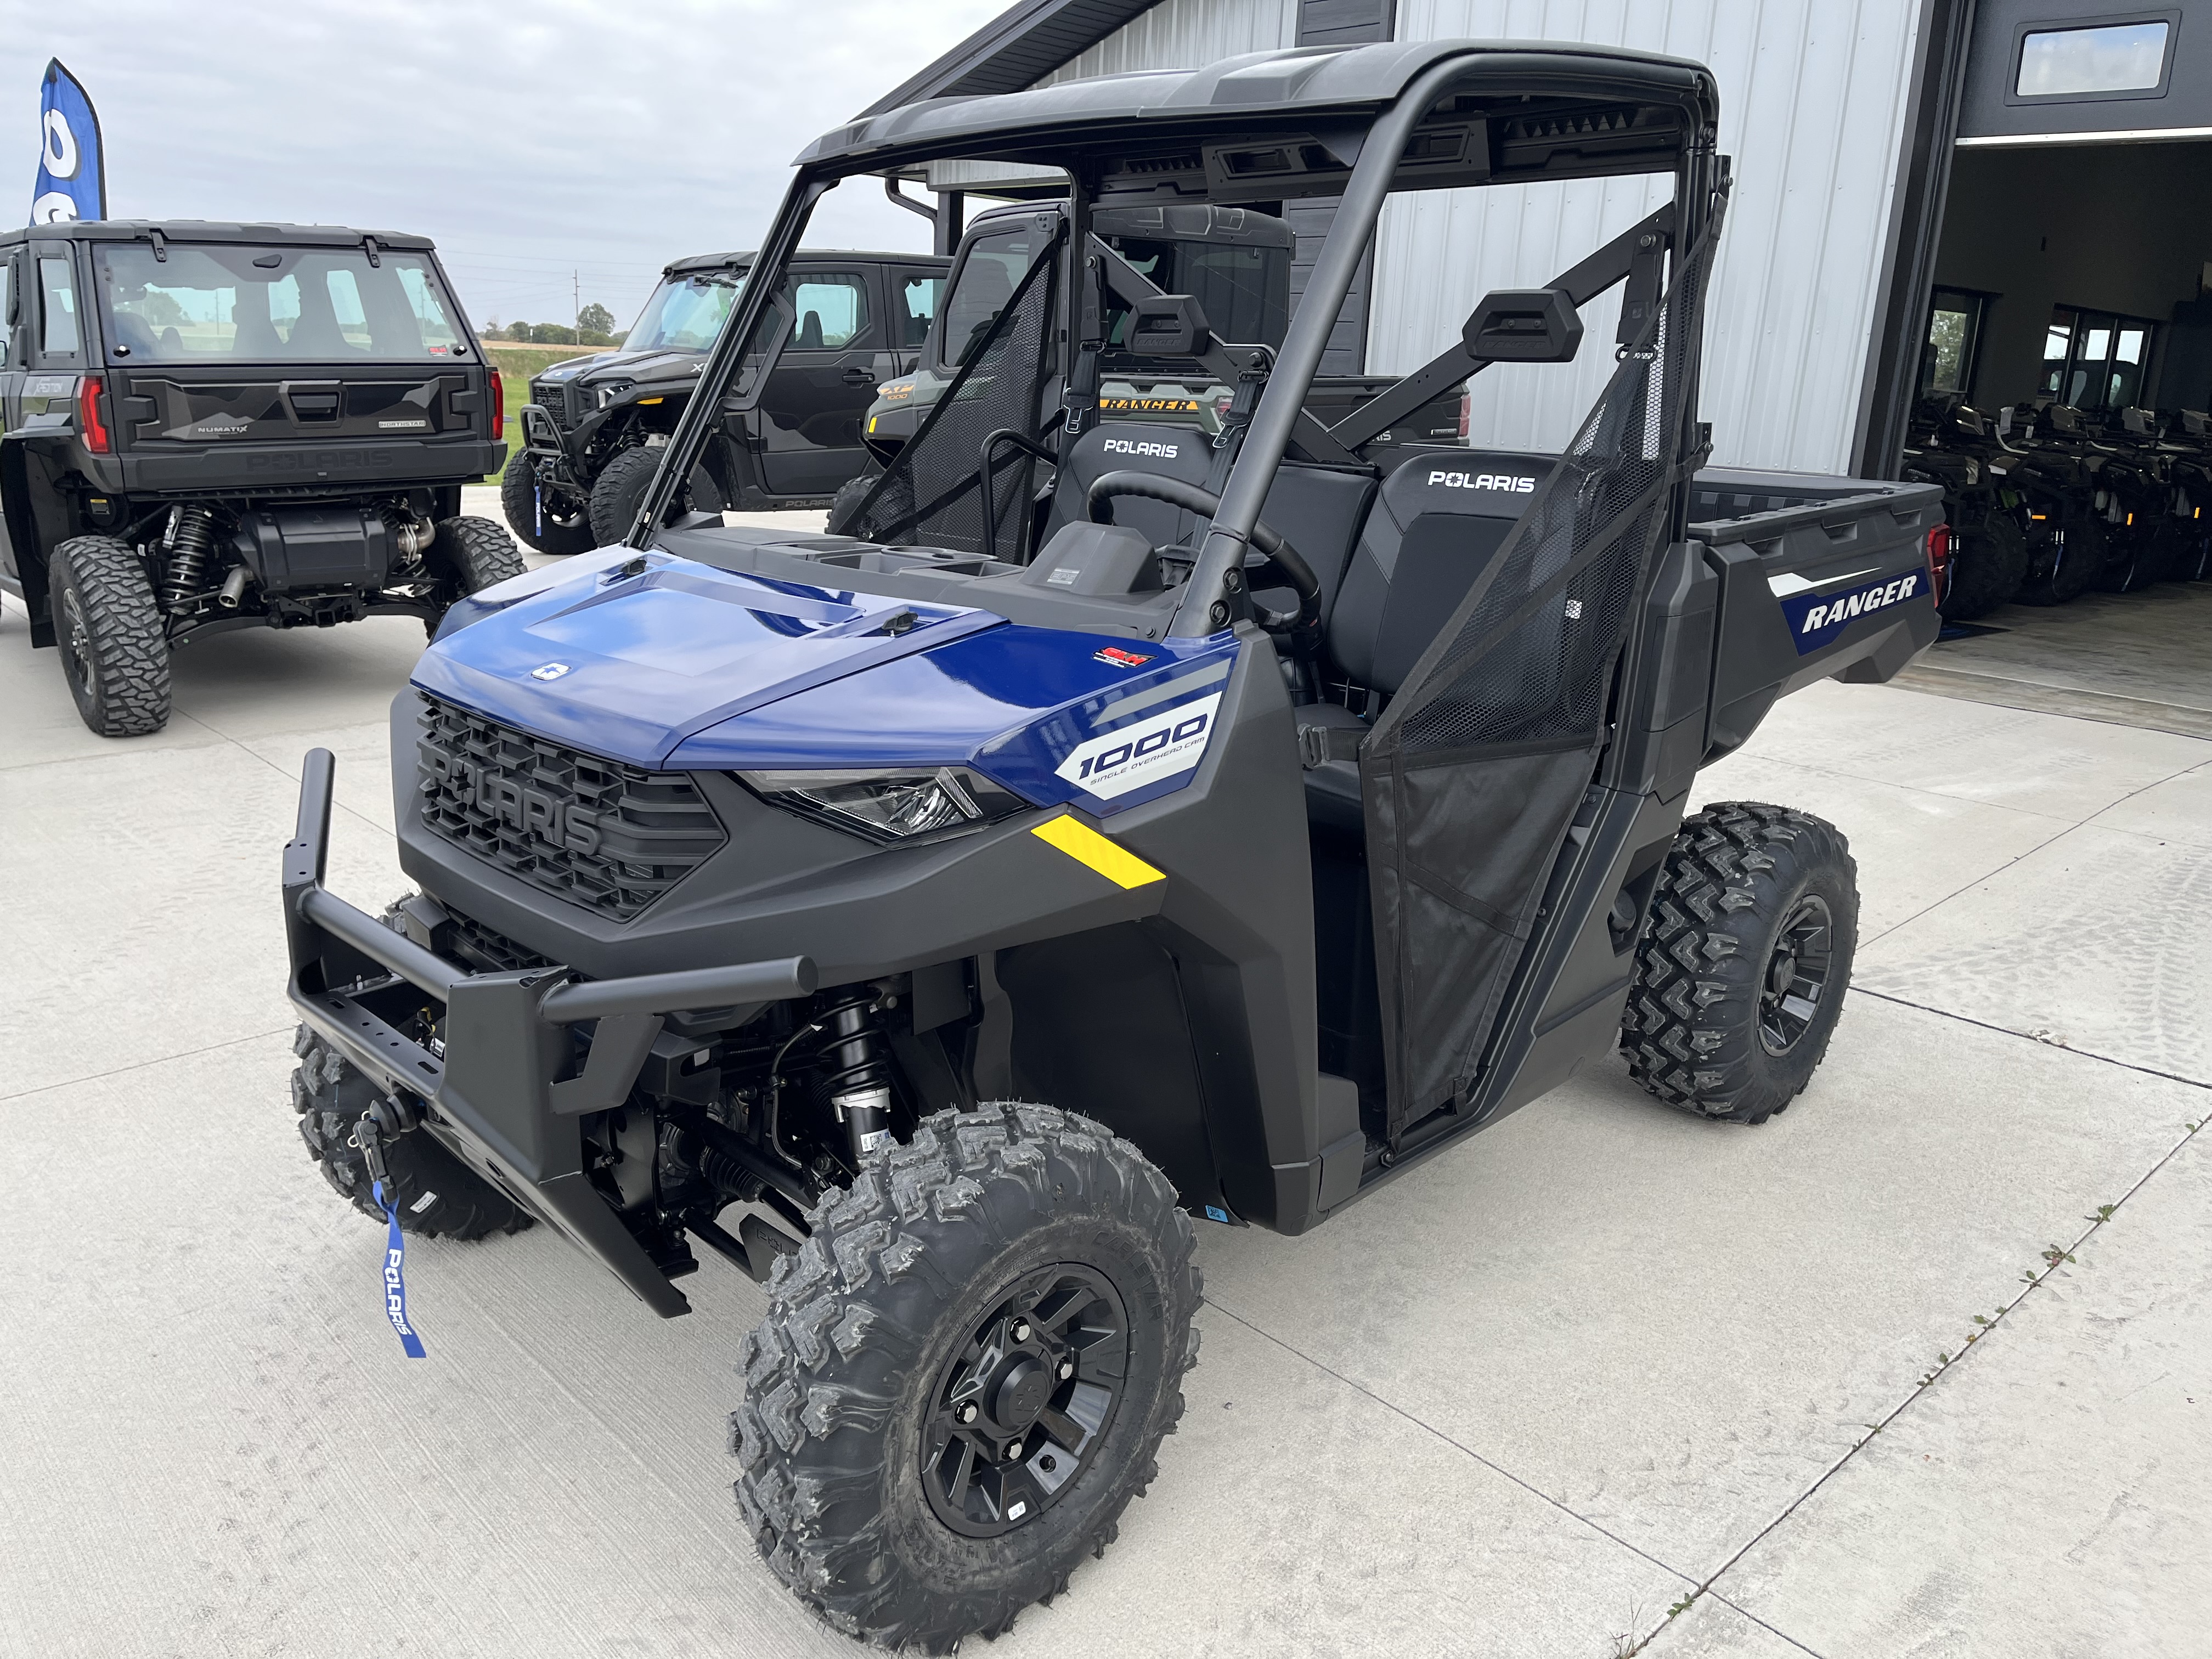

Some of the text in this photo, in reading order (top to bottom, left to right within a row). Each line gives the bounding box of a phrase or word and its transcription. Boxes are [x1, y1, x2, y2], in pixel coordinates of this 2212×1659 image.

[1105, 399, 1192, 410] RANGER
[247, 450, 393, 471] POLARIS
[1103, 439, 1178, 458] POLARIS
[1427, 471, 1536, 493] POLARIS
[1802, 575, 1917, 634] RANGER
[1079, 713, 1208, 780] 1000
[1090, 736, 1205, 786] SINGLE OVERHEAD CAM
[430, 744, 602, 855] POLARIS
[384, 1248, 412, 1335] POLARIS
